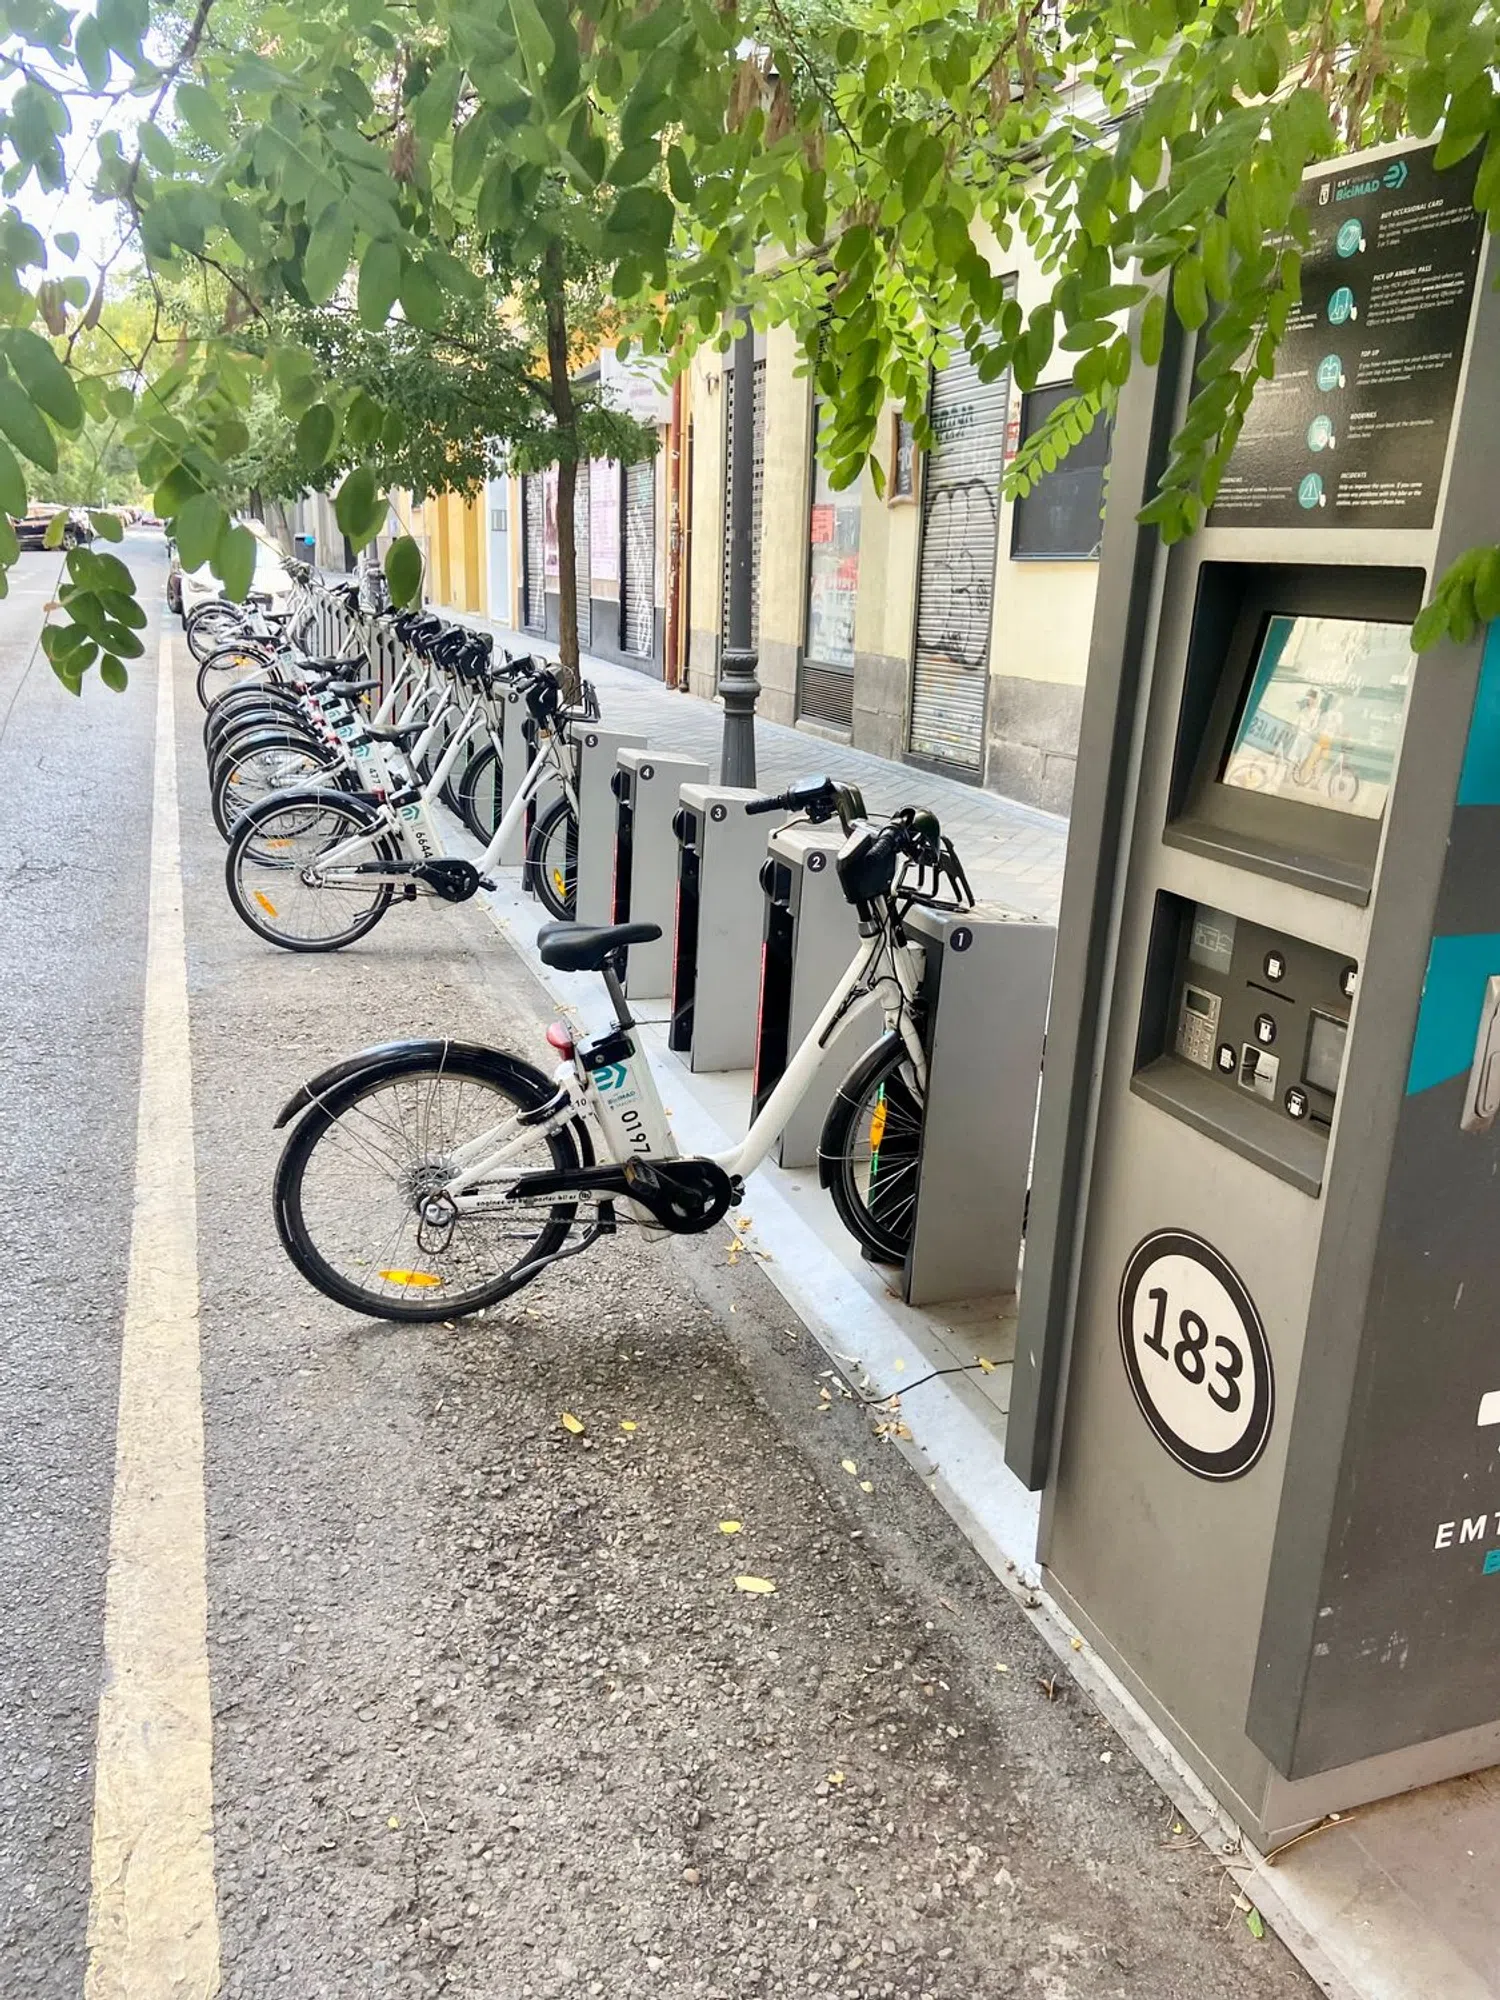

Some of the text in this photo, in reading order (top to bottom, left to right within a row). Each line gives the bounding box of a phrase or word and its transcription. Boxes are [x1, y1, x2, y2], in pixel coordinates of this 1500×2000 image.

[1336, 180, 1380, 201] BiciMAD
[1392, 203, 1426, 216] OCCASIONAL
[1428, 199, 1443, 208] CARD
[1418, 264, 1432, 273] PASS
[642, 767, 651, 778] 4
[714, 808, 723, 819] 3
[415, 831, 434, 860] 6644
[812, 856, 821, 869] 2
[957, 932, 964, 947] 1
[621, 1110, 652, 1153] 0197
[1143, 1287, 1244, 1414] 183
